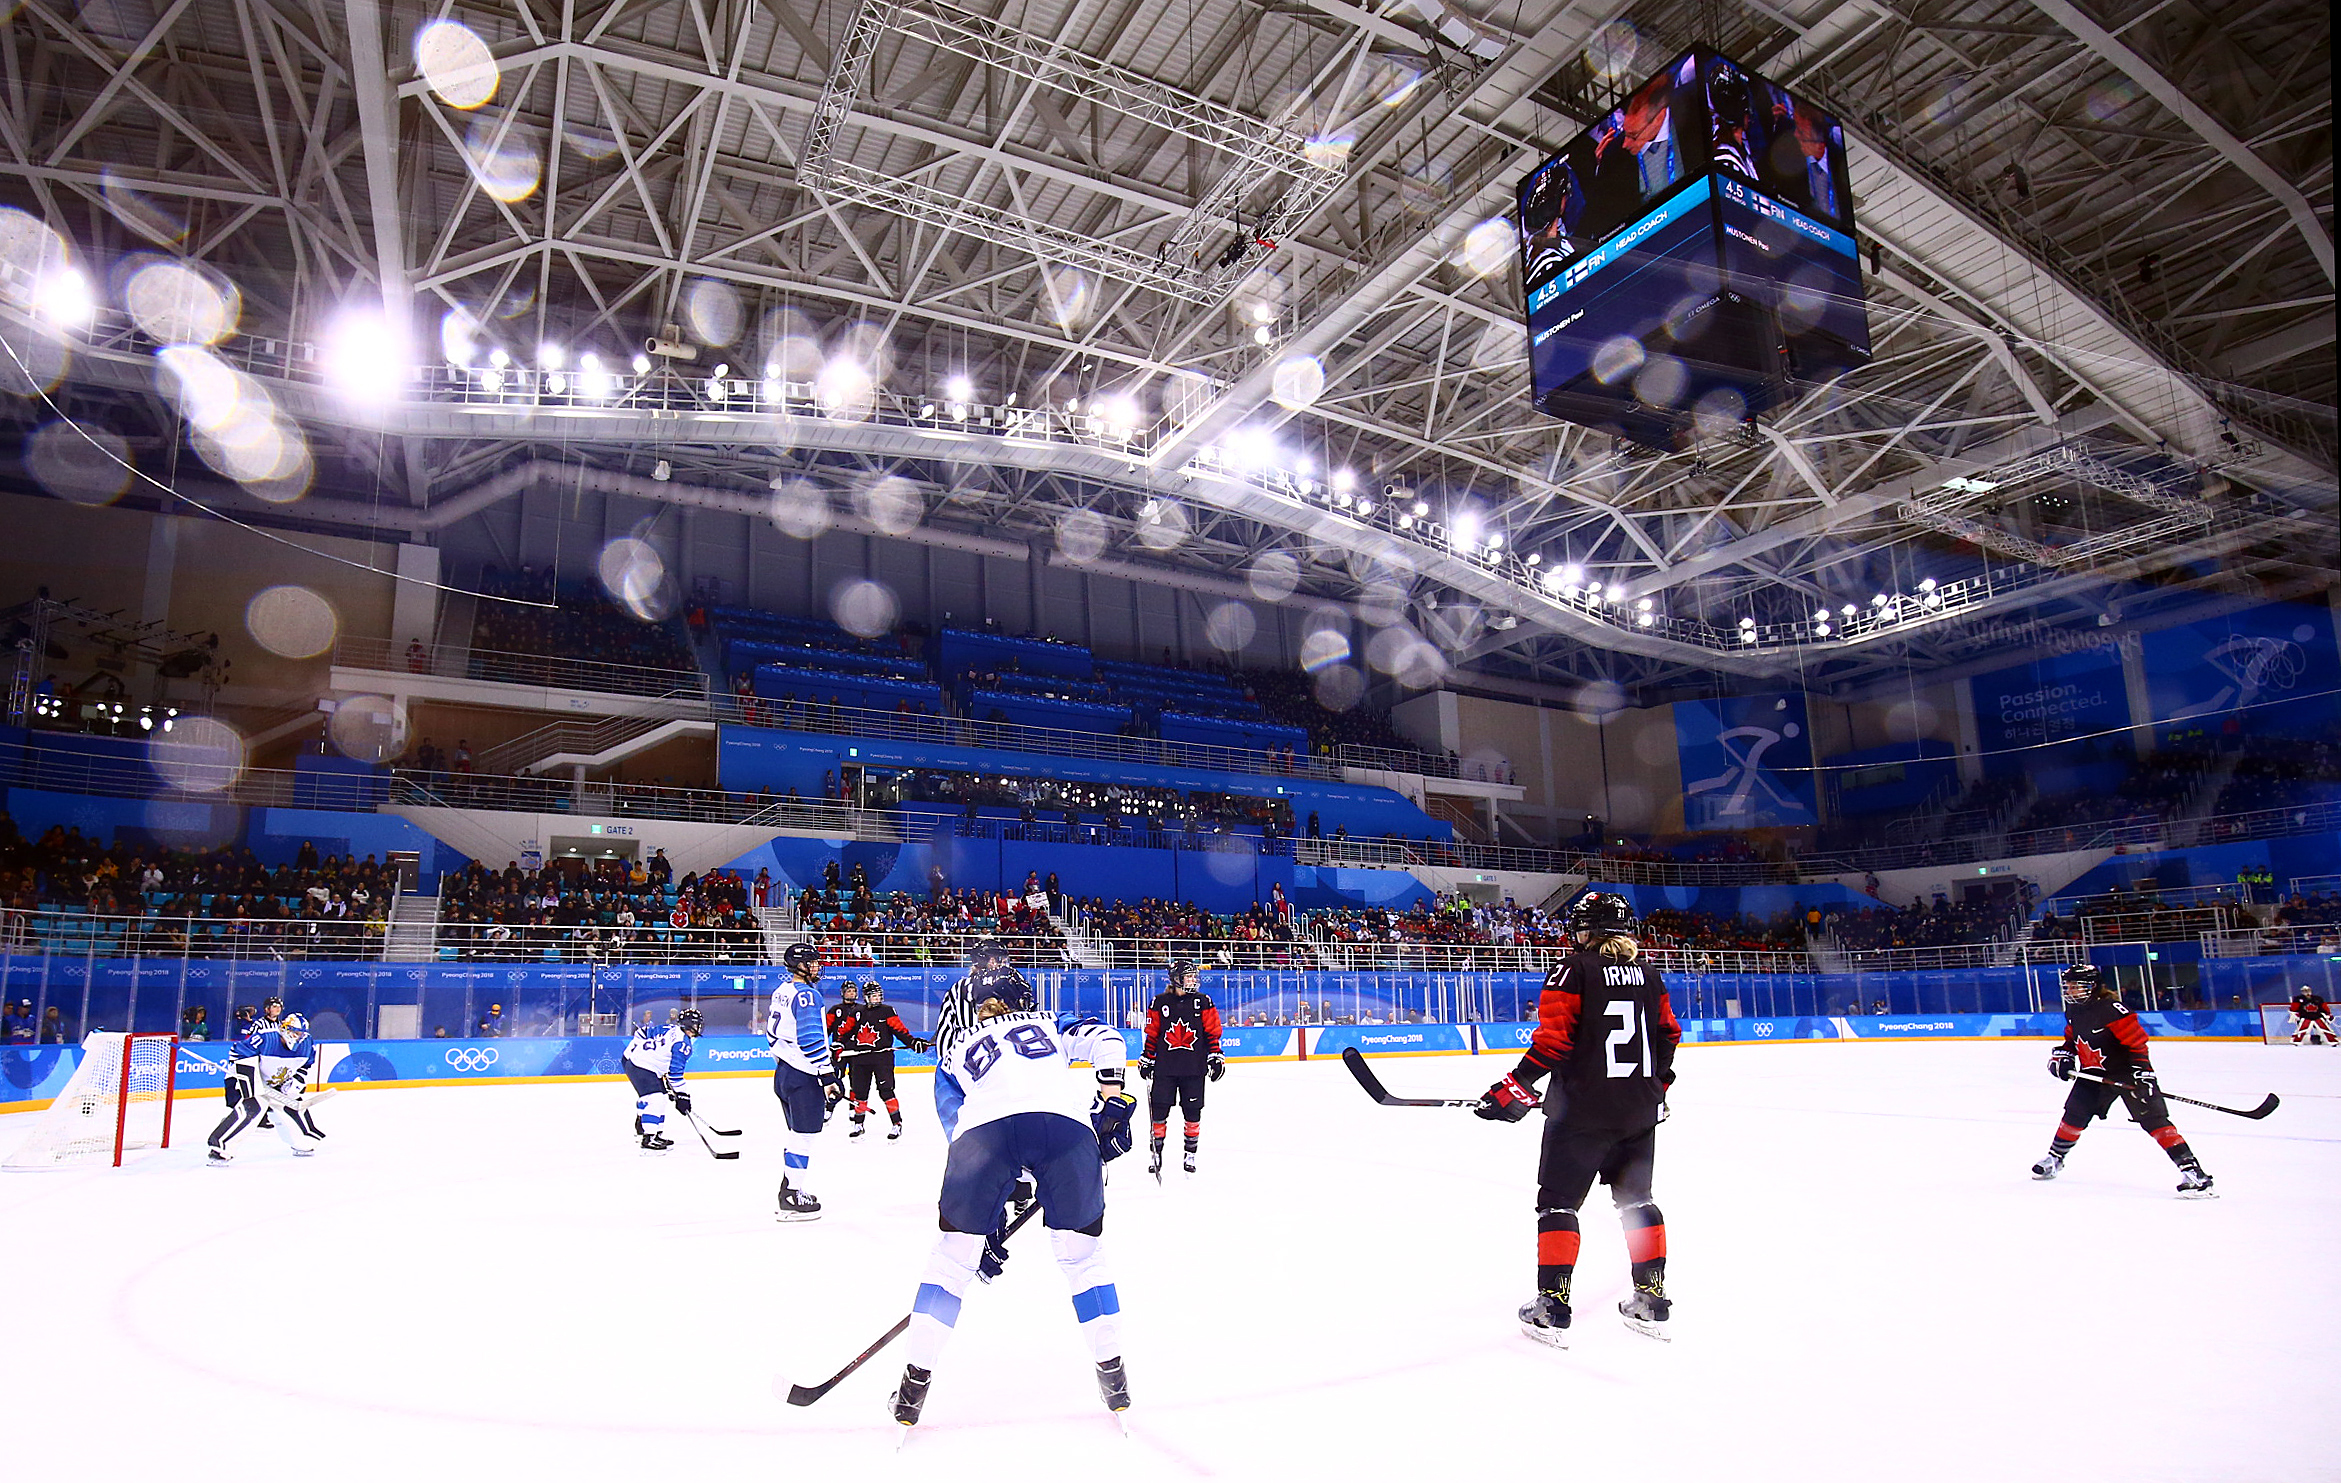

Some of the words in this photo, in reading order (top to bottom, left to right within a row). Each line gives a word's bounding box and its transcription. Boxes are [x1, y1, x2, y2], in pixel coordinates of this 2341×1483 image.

[1726, 181, 1744, 198] 4.5
[1770, 204, 1786, 220] FIN
[1615, 233, 1637, 251] HEAD
[1637, 210, 1668, 235] COACH
[1792, 216, 1808, 230] HEAD
[1808, 225, 1831, 240] COACH
[1587, 250, 1606, 272] FIN
[1537, 280, 1557, 302] 4.5
[1695, 296, 1720, 313] OMEGA
[1535, 317, 1571, 346] MUSTONEN
[2000, 684, 2082, 710] Passion.
[2001, 691, 2107, 724] Connected.
[606, 826, 626, 835] GATE
[628, 827, 633, 837] 2
[1617, 908, 1625, 918] 21
[1546, 963, 1571, 987] 21
[1603, 965, 1645, 987] IRWIN
[797, 991, 816, 1008] 61
[1193, 998, 1201, 1010] C
[2112, 1002, 2129, 1014] 8
[1879, 1022, 1933, 1032] PyeongChang
[1934, 1022, 1954, 1030] 2018
[250, 1034, 263, 1049] 41
[1222, 1038, 1241, 1047] 2018
[1361, 1034, 1407, 1046] PyeongChang
[1407, 1034, 1423, 1043] 2018
[1603, 1000, 1652, 1078] 21
[679, 1042, 692, 1056] 15
[709, 1048, 773, 1062] PyeongCha
[963, 1023, 1058, 1082] 88
[1501, 1077, 1538, 1107] CCM
